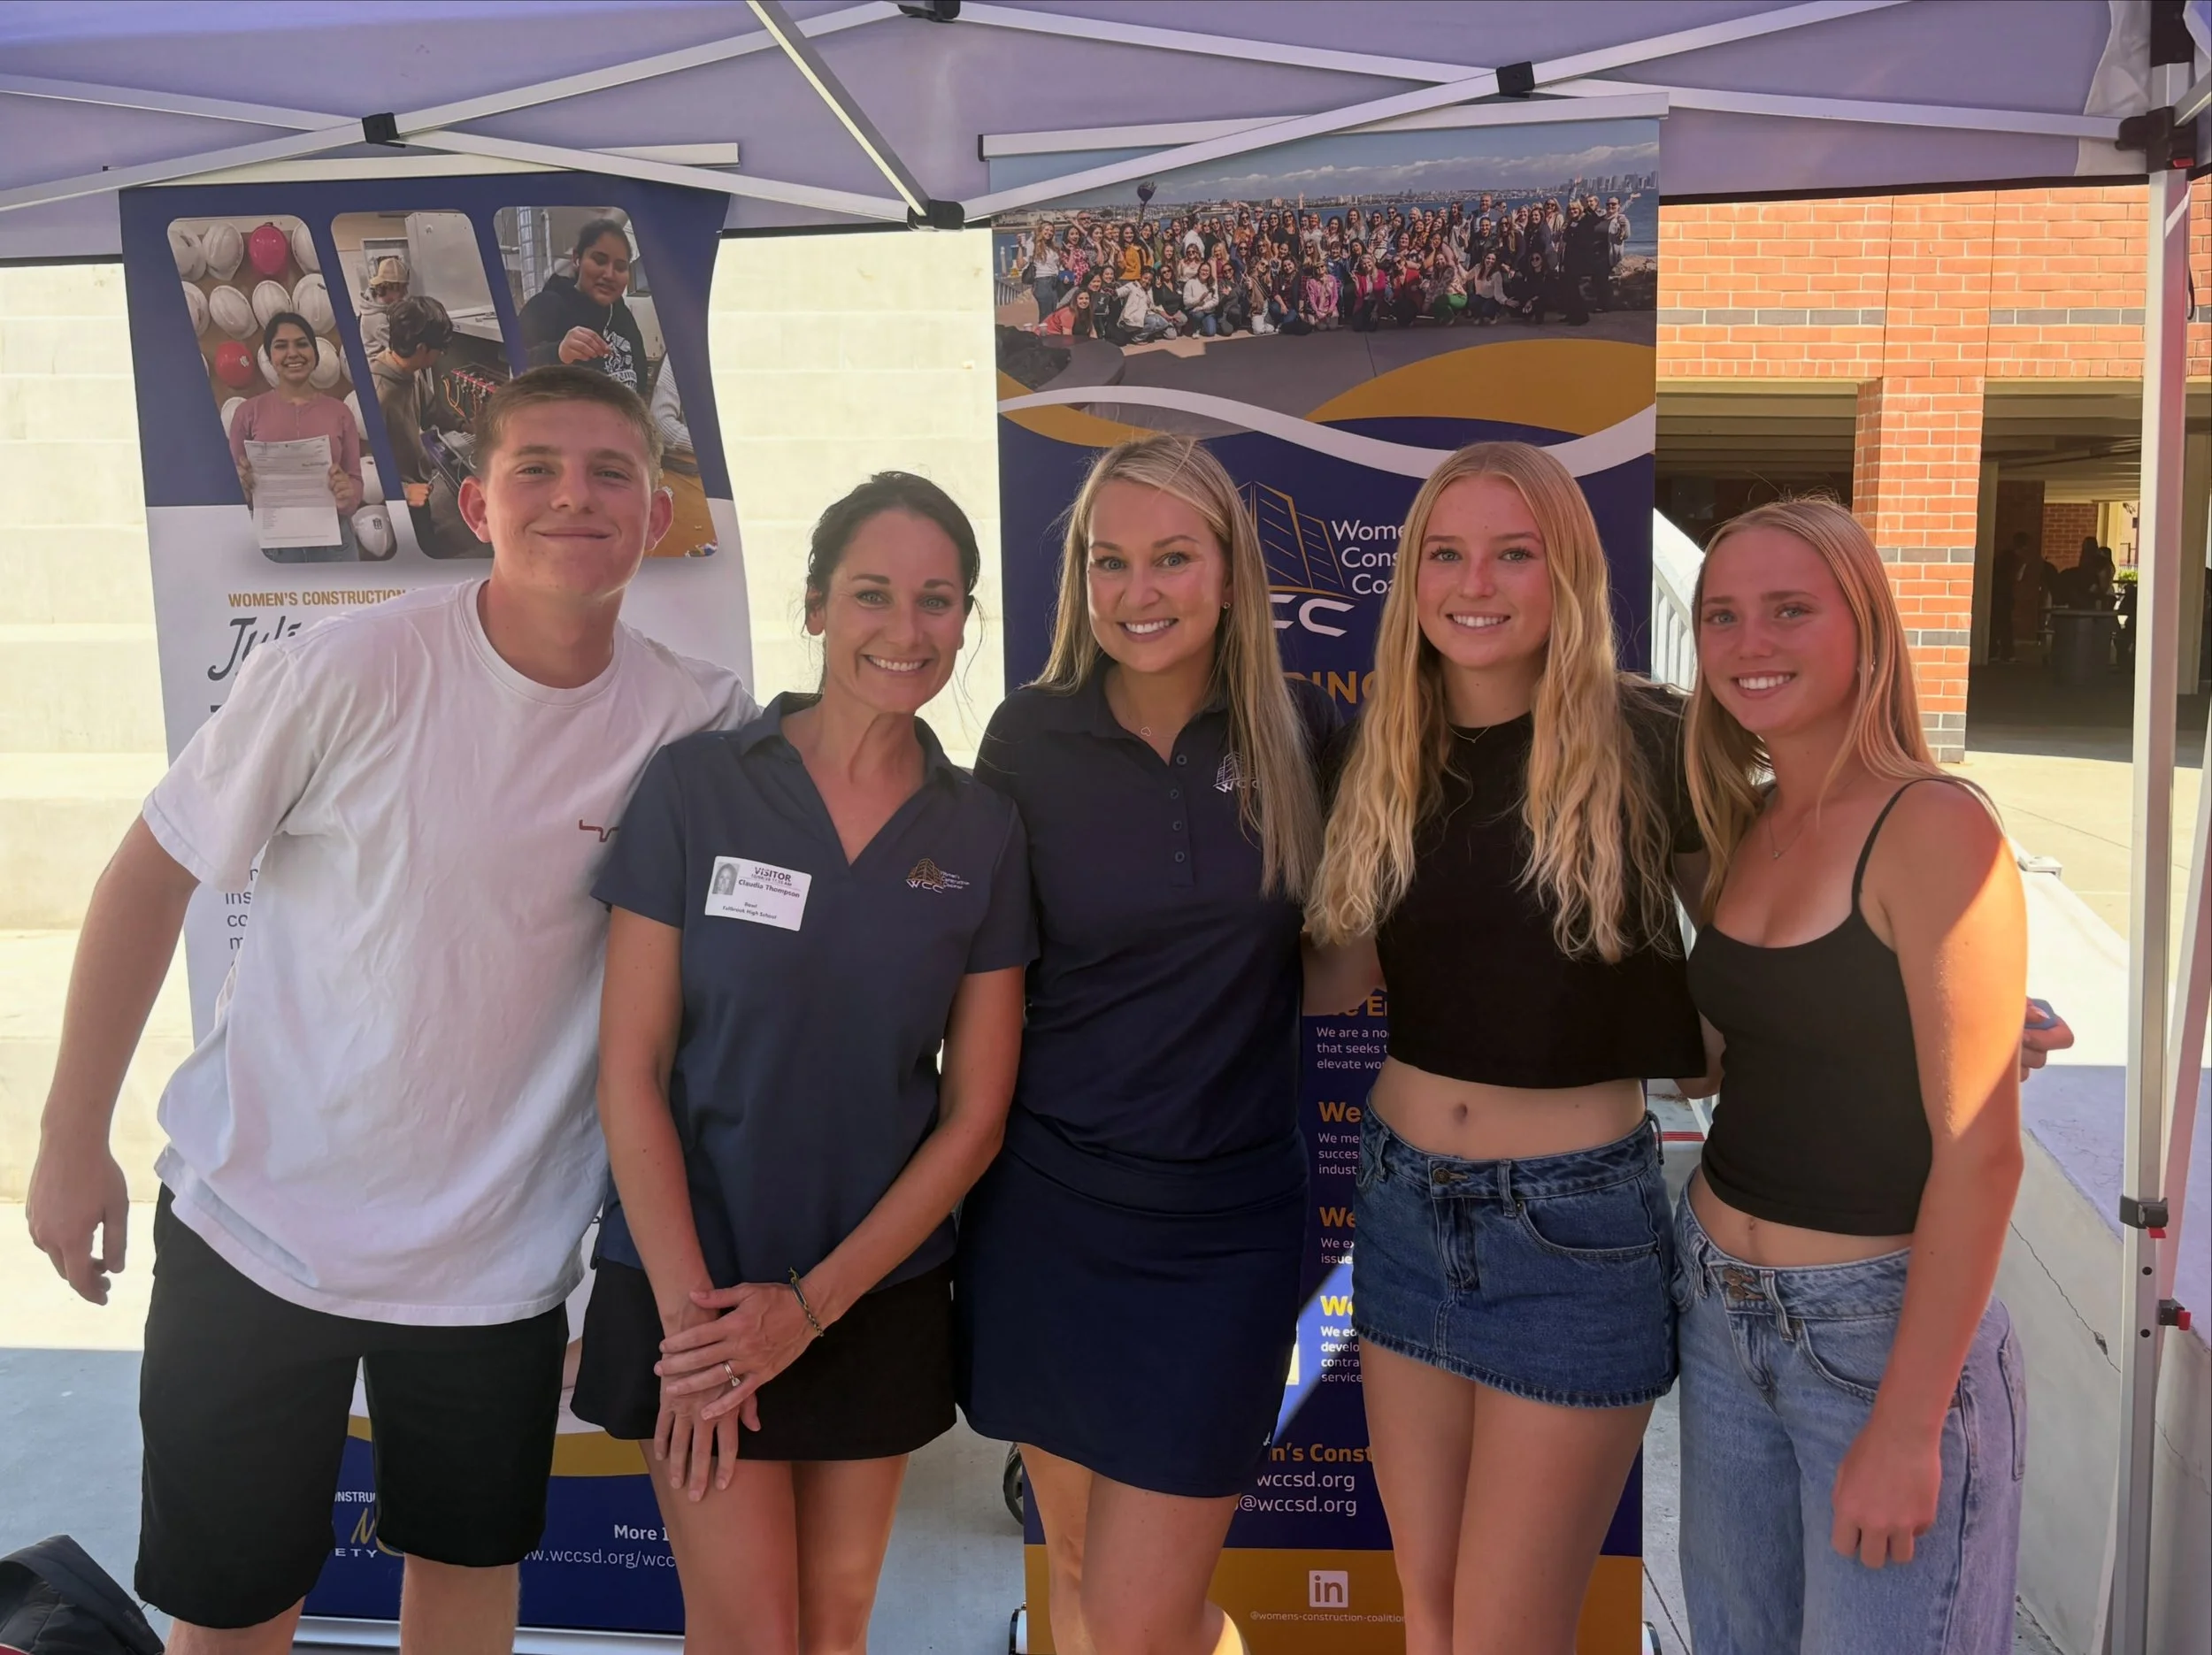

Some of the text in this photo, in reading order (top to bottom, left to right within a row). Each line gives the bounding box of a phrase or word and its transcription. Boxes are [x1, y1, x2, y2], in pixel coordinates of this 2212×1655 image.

[228, 592, 297, 608] WOMEN'S
[755, 867, 791, 882] VISITOR
[739, 879, 764, 889] Claudia
[765, 884, 800, 898] Thompson
[906, 880, 944, 893] WCC
[1317, 1027, 1336, 1038] We
[1317, 1043, 1342, 1053] that
[1344, 1044, 1380, 1054] seeks
[1317, 1059, 1361, 1069] elevate
[1318, 1101, 1362, 1122] We
[1318, 1133, 1337, 1143] We
[1321, 1238, 1340, 1248] We
[1320, 1326, 1340, 1337] We
[614, 1524, 657, 1540] More
